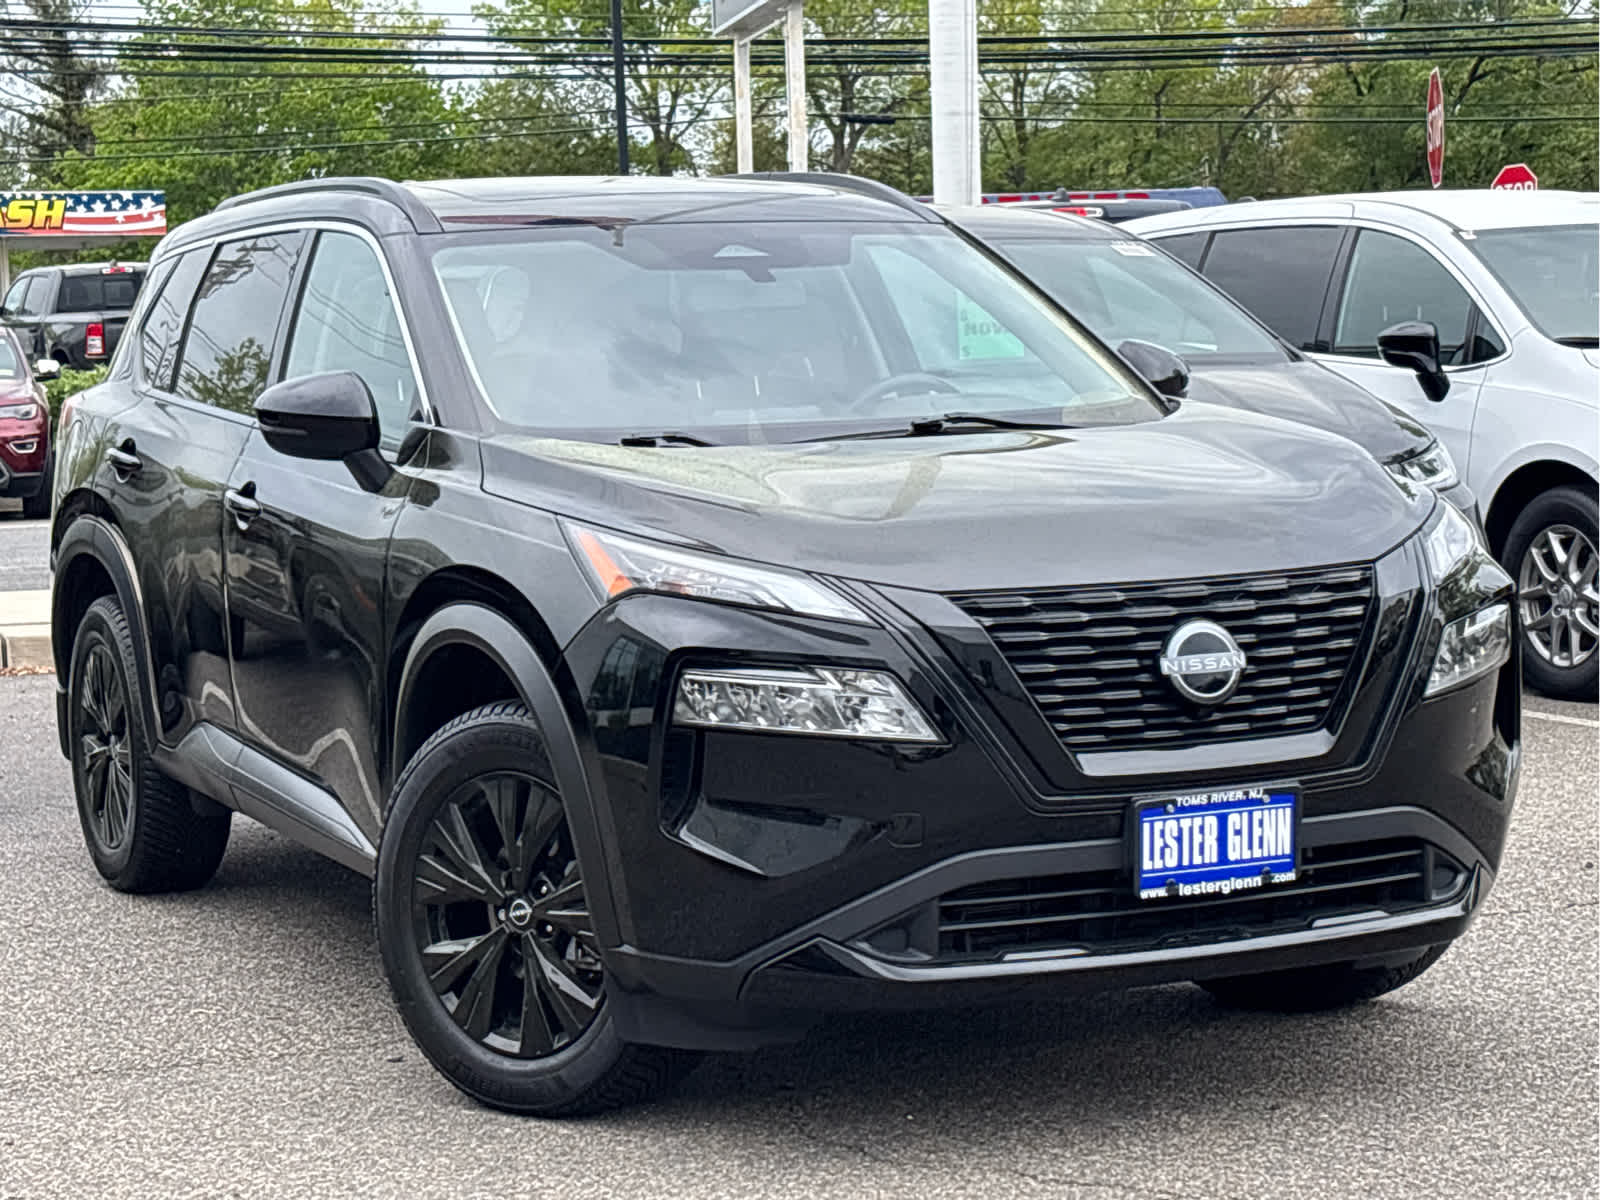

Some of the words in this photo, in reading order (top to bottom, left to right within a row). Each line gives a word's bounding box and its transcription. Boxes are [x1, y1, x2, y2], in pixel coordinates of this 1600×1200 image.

[1162, 655, 1243, 672] NISSAN
[1176, 794, 1208, 807] TOMS
[1248, 787, 1264, 800] NJ
[1142, 815, 1218, 871] LESTER
[1227, 807, 1292, 862] GLENN
